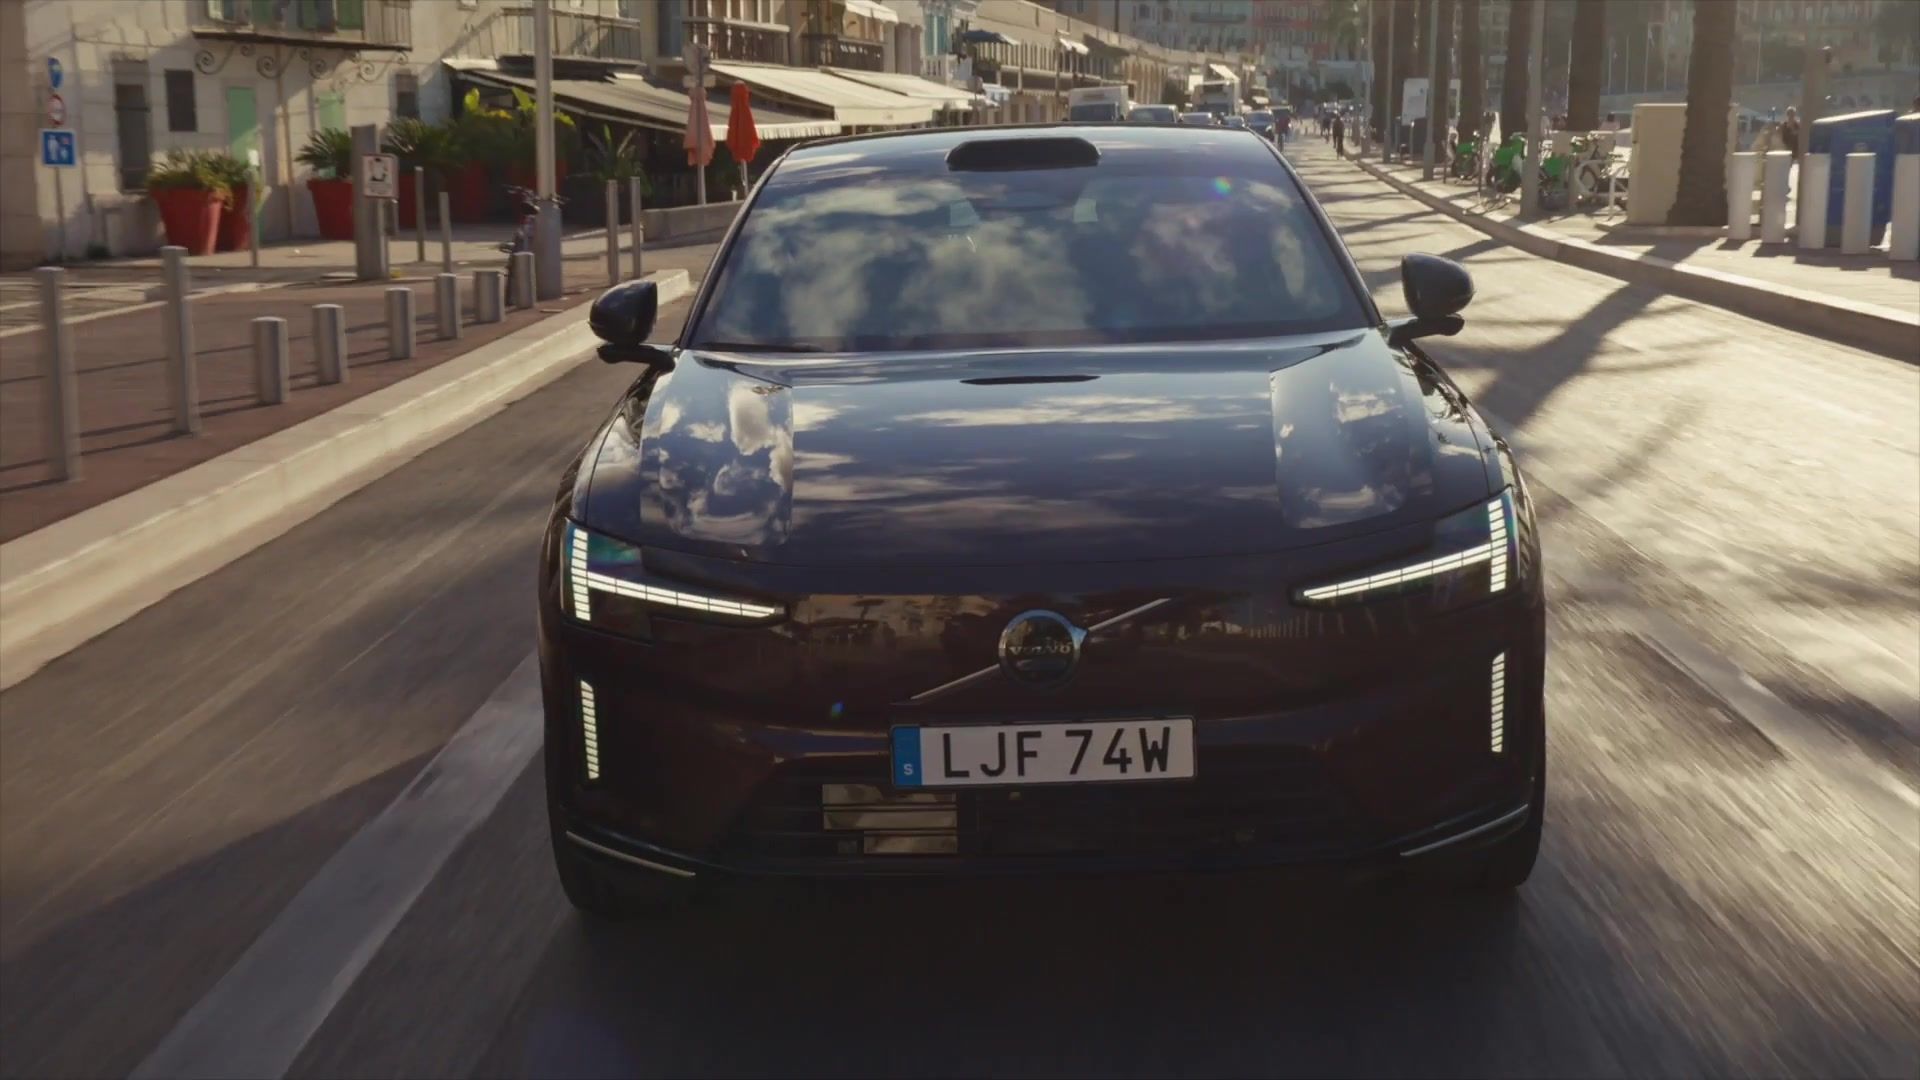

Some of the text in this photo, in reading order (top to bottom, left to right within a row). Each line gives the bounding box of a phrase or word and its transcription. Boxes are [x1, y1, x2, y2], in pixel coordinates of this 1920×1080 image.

[943, 726, 1171, 778] LJF 74W
[903, 763, 914, 776] S
